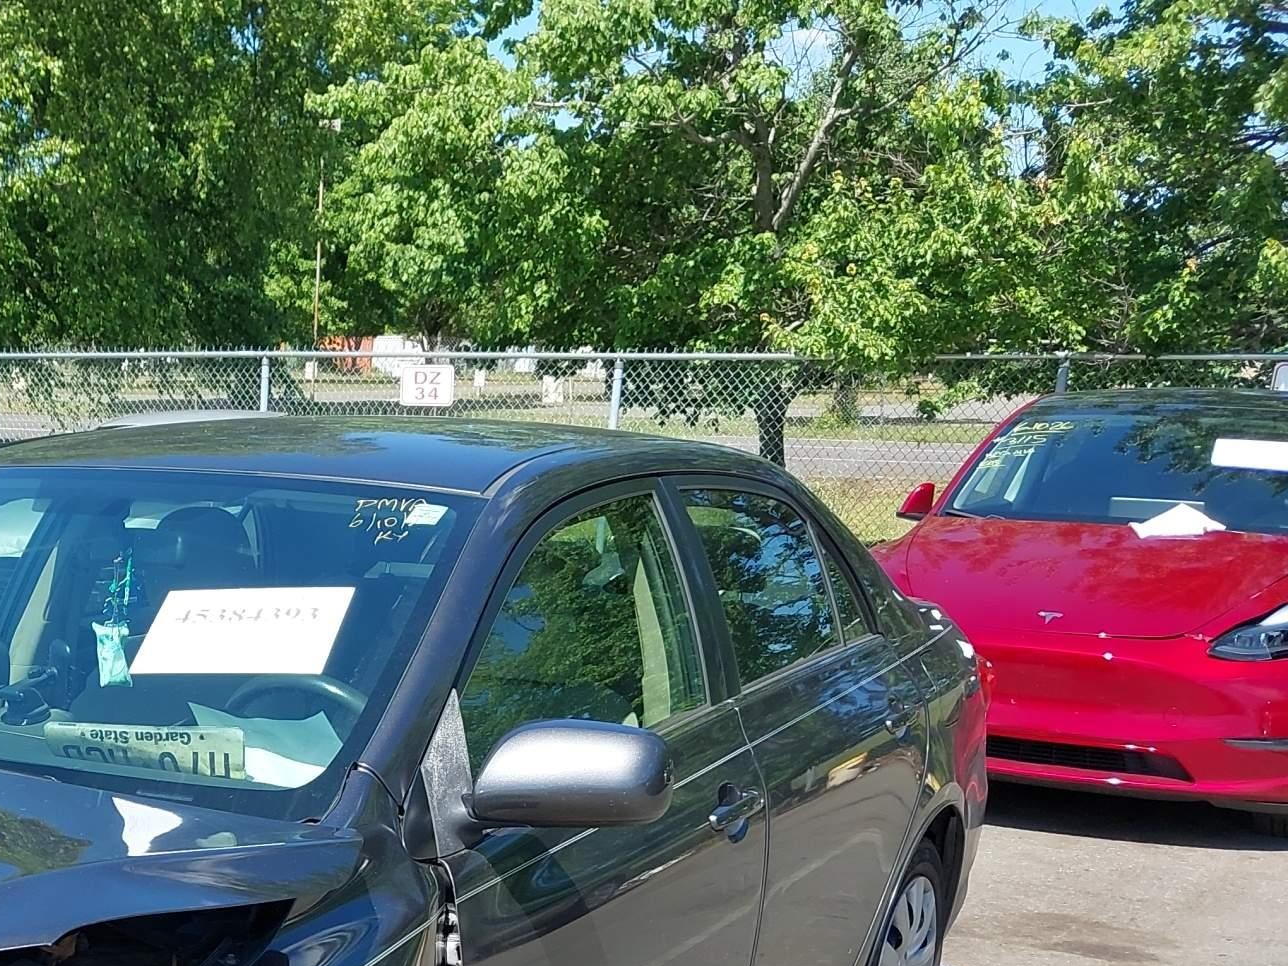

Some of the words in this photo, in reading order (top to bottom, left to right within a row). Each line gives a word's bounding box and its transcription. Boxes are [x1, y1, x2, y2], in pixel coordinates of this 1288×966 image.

[414, 371, 441, 385] DZ
[415, 387, 439, 400] 34
[89, 728, 130, 745] State
[134, 730, 192, 747] Garden
